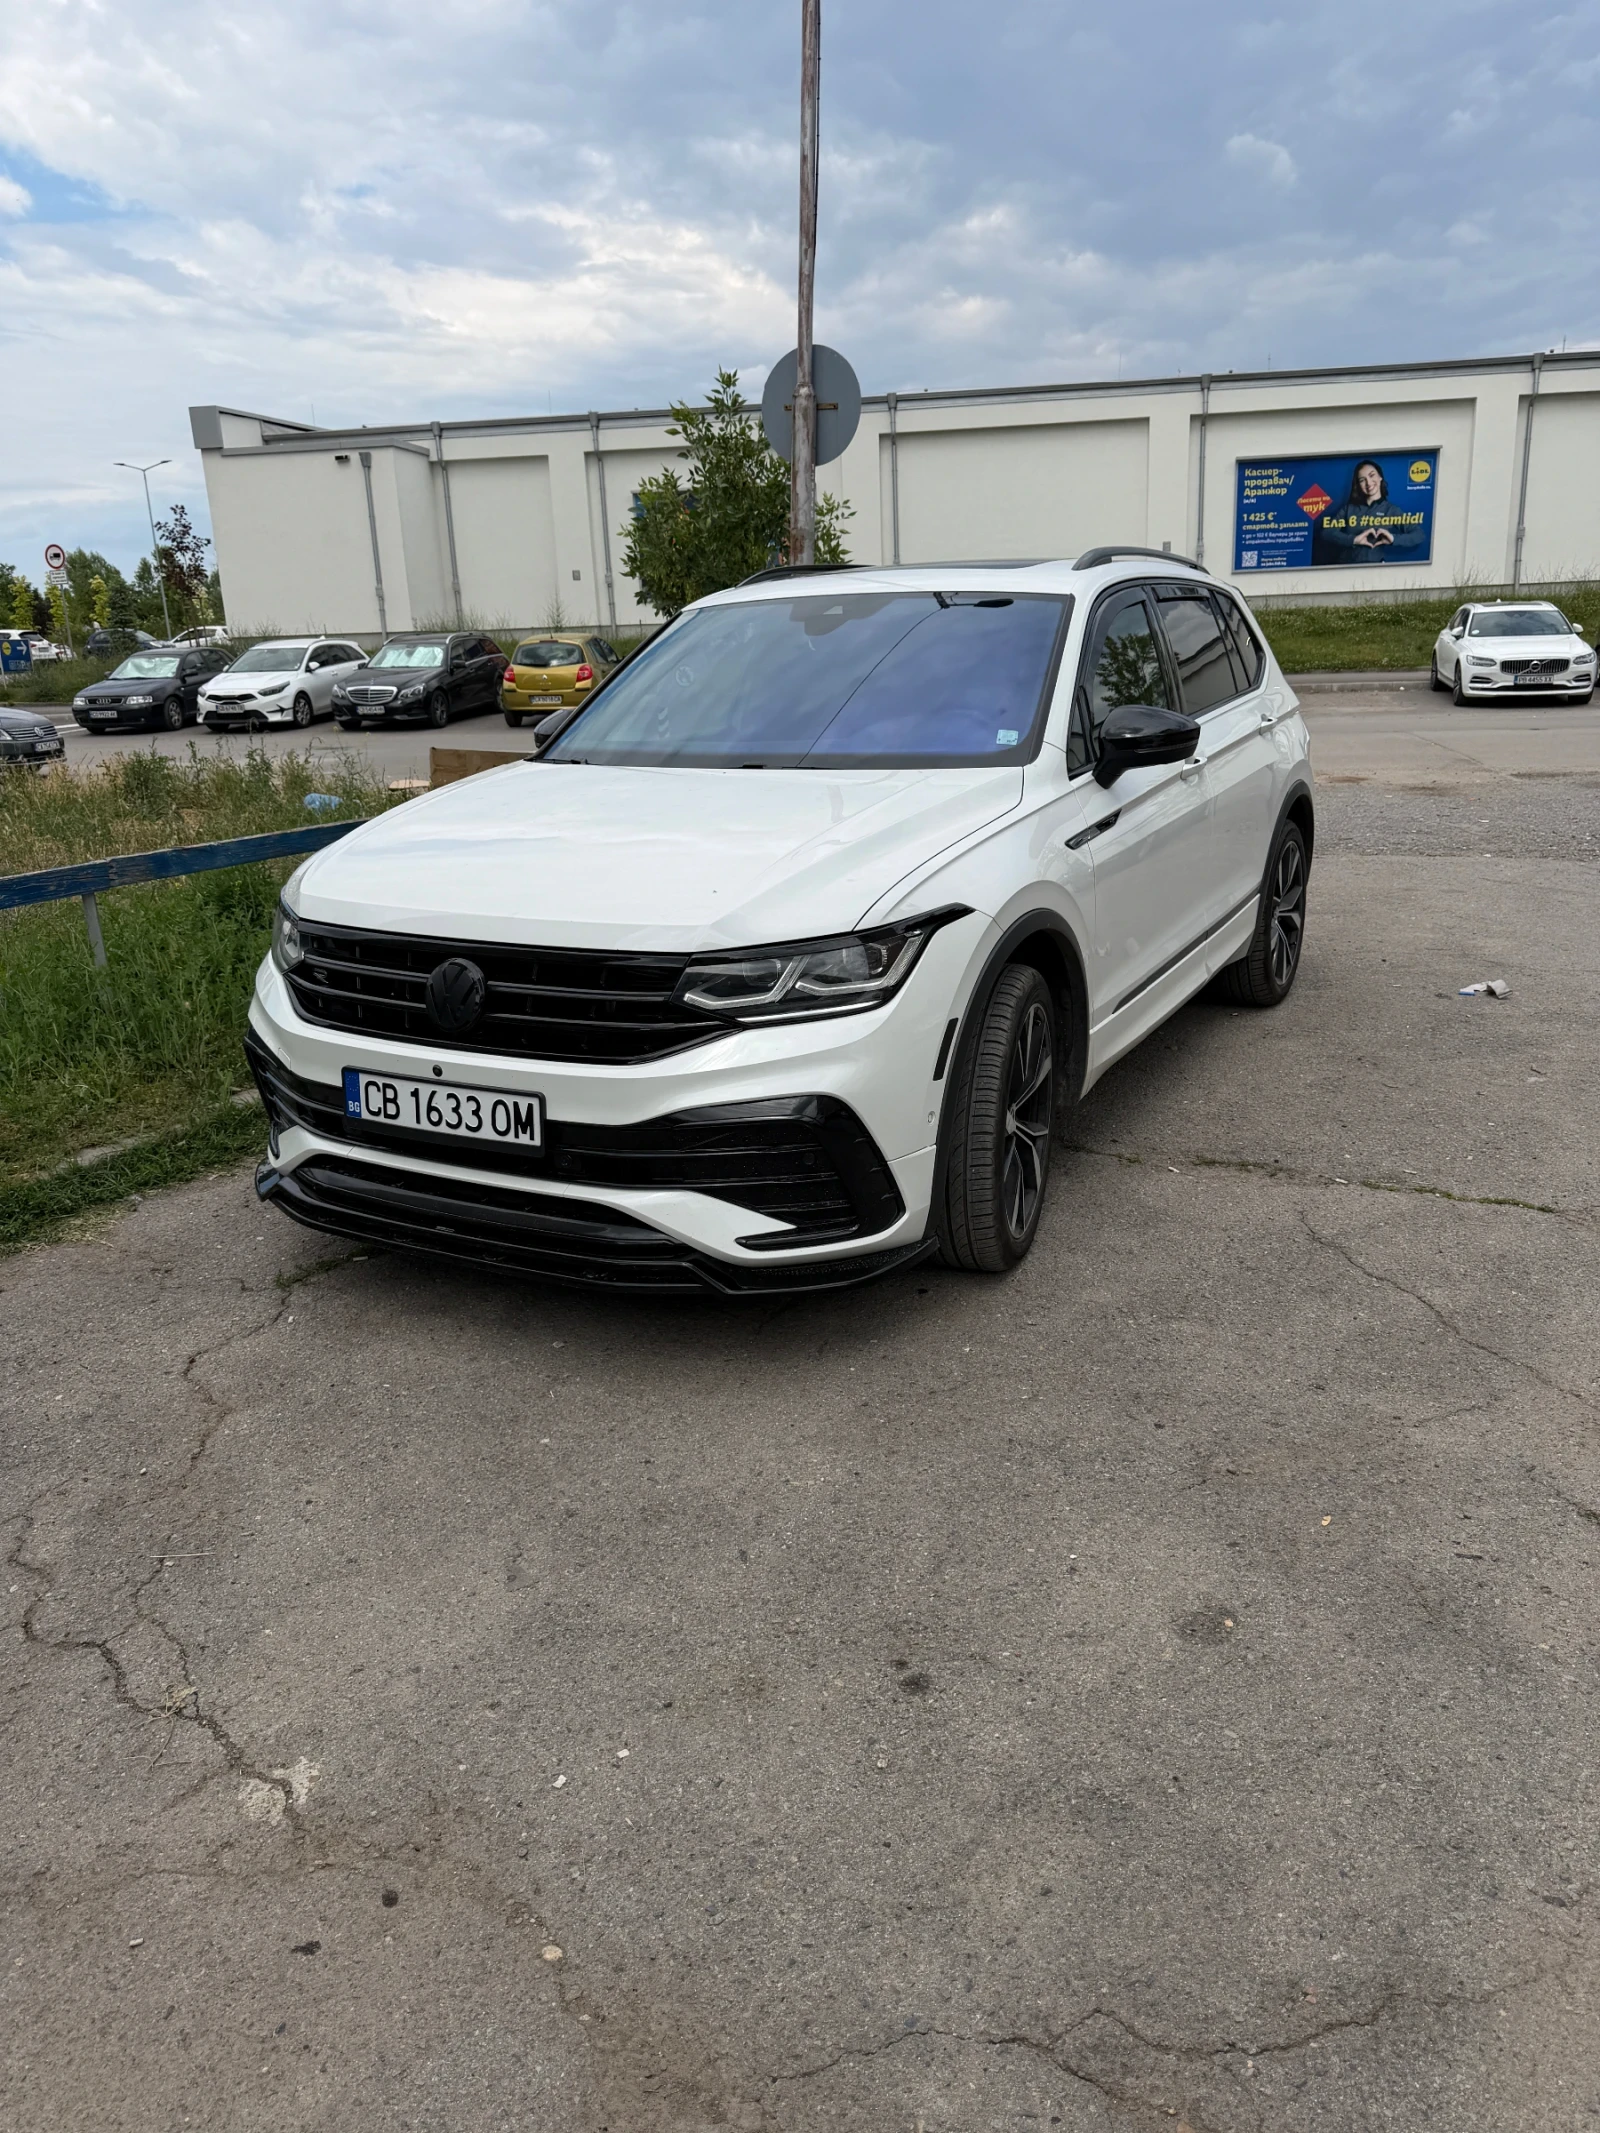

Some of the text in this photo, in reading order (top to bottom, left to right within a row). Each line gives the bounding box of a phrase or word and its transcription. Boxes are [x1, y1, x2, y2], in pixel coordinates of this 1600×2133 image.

[1244, 468, 1283, 477] Касиер-
[1243, 475, 1295, 487] продавач/
[1243, 486, 1287, 497] Аранжор
[1303, 501, 1326, 514] тук
[1322, 512, 1424, 529] Ела в #teamlidl
[348, 1100, 361, 1114] BG
[364, 1080, 535, 1142] CB 1633 OM
